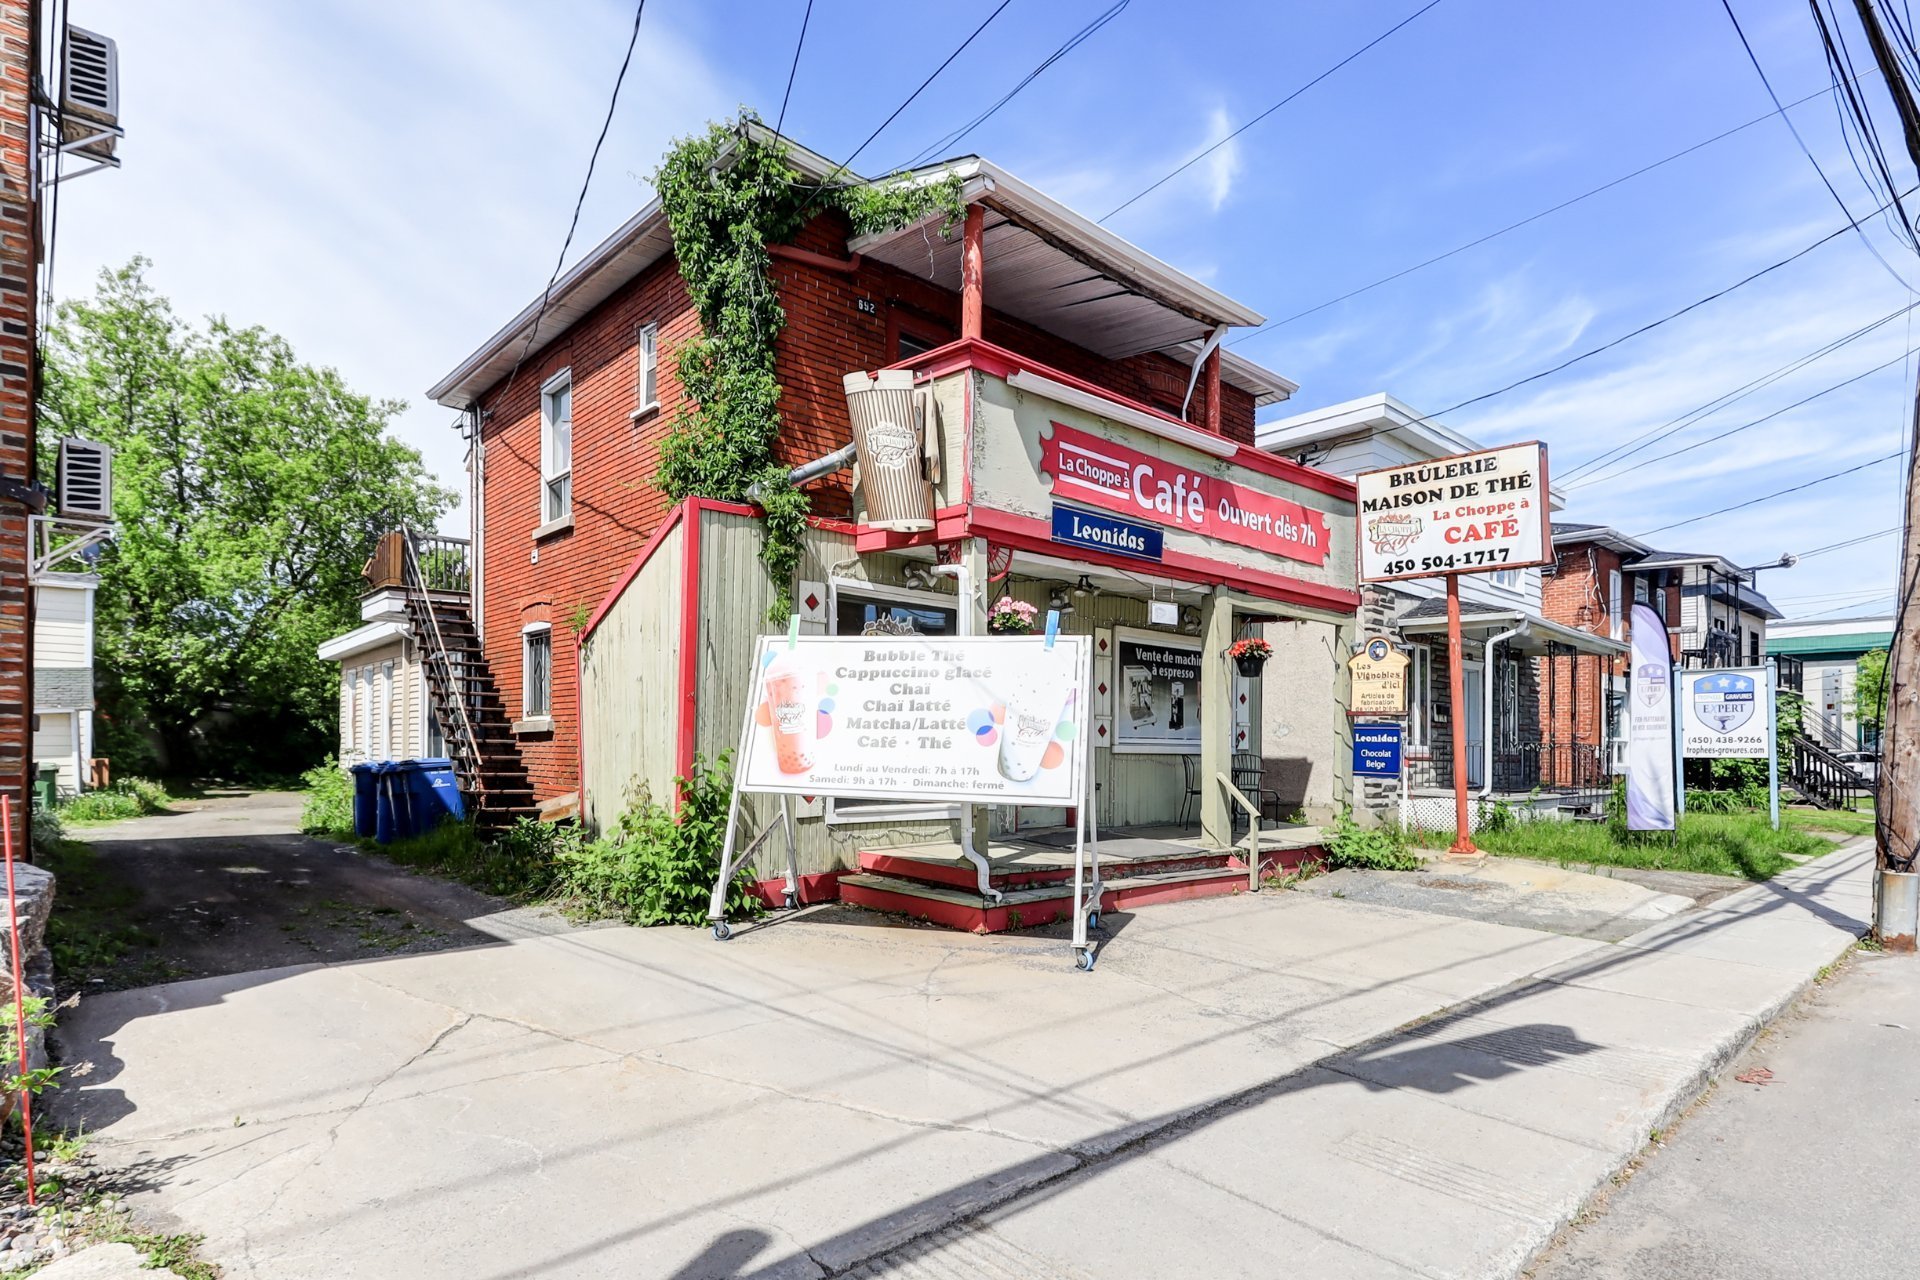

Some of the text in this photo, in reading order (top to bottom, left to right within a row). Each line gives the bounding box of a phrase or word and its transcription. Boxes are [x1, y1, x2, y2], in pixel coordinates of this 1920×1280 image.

[1059, 453, 1130, 489] La Choppe à
[1389, 456, 1498, 488] BRÛLERIE
[1132, 464, 1205, 523] Café
[1362, 471, 1532, 513] MAISON DE THÉ
[1433, 498, 1530, 521] La Choppe à
[1218, 498, 1317, 548] Ouvert dès 7h
[1444, 514, 1519, 544] CAFÉ
[1072, 516, 1145, 551] Leonidas
[1384, 548, 1510, 575] 450 504-1717
[864, 650, 965, 662] Bubble Thé
[1135, 647, 1162, 662] Vente
[1163, 651, 1174, 664] de
[1152, 663, 1194, 679] à espresso
[1356, 662, 1371, 670] Les
[835, 666, 992, 681] Cappuccino glacé
[1356, 671, 1400, 680] Vignobles
[889, 683, 931, 695] Chaï
[863, 699, 951, 712] Chaï latté
[1703, 703, 1746, 713] EXPERT
[846, 717, 966, 731] Matcha/Latté
[857, 735, 897, 748] Café
[918, 736, 952, 749] Thé
[1355, 733, 1398, 743] Leonidas
[1688, 736, 1762, 745] (450) 438-9266
[1360, 749, 1391, 758] Chocolat
[1687, 745, 1765, 756] trophees-gravures.com
[834, 763, 863, 772] Lundi
[882, 765, 931, 775] Vendredi:
[934, 766, 947, 775] 7h
[950, 767, 956, 775] à
[961, 767, 980, 776] 17h
[1366, 760, 1386, 769] Belge
[809, 775, 849, 784] Samedi:
[853, 776, 865, 785] 9h
[868, 776, 875, 785] à
[879, 777, 897, 786] 17h
[912, 778, 969, 789] Dimanche:
[972, 780, 1005, 790] fermé
